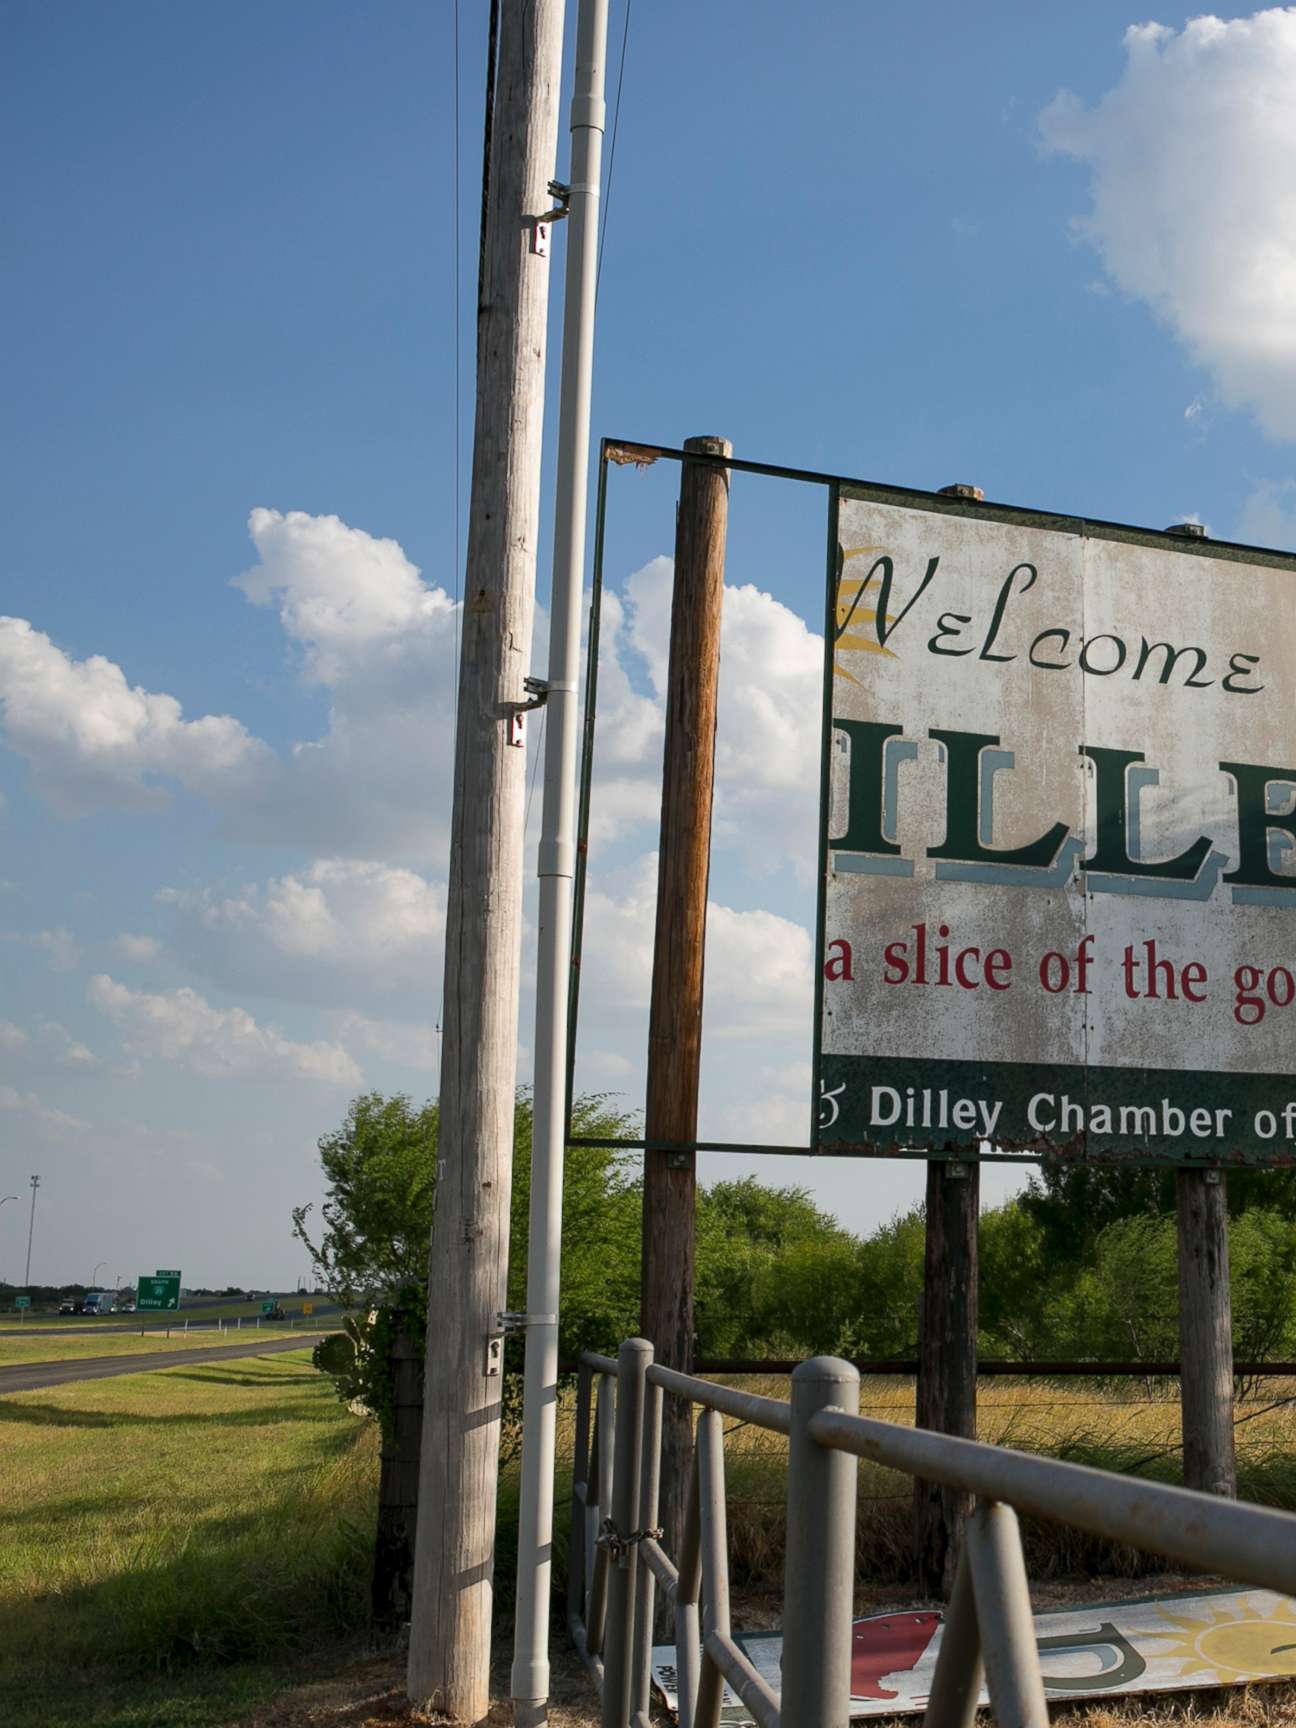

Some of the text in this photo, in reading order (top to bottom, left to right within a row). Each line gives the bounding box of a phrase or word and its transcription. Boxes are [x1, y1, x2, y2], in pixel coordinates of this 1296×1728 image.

[824, 938, 855, 982] a
[882, 922, 1013, 992] slice
[1039, 934, 1095, 995] of
[1121, 939, 1208, 1003] the
[869, 1085, 1003, 1138] Dilley
[1026, 1092, 1233, 1137] Chamber
